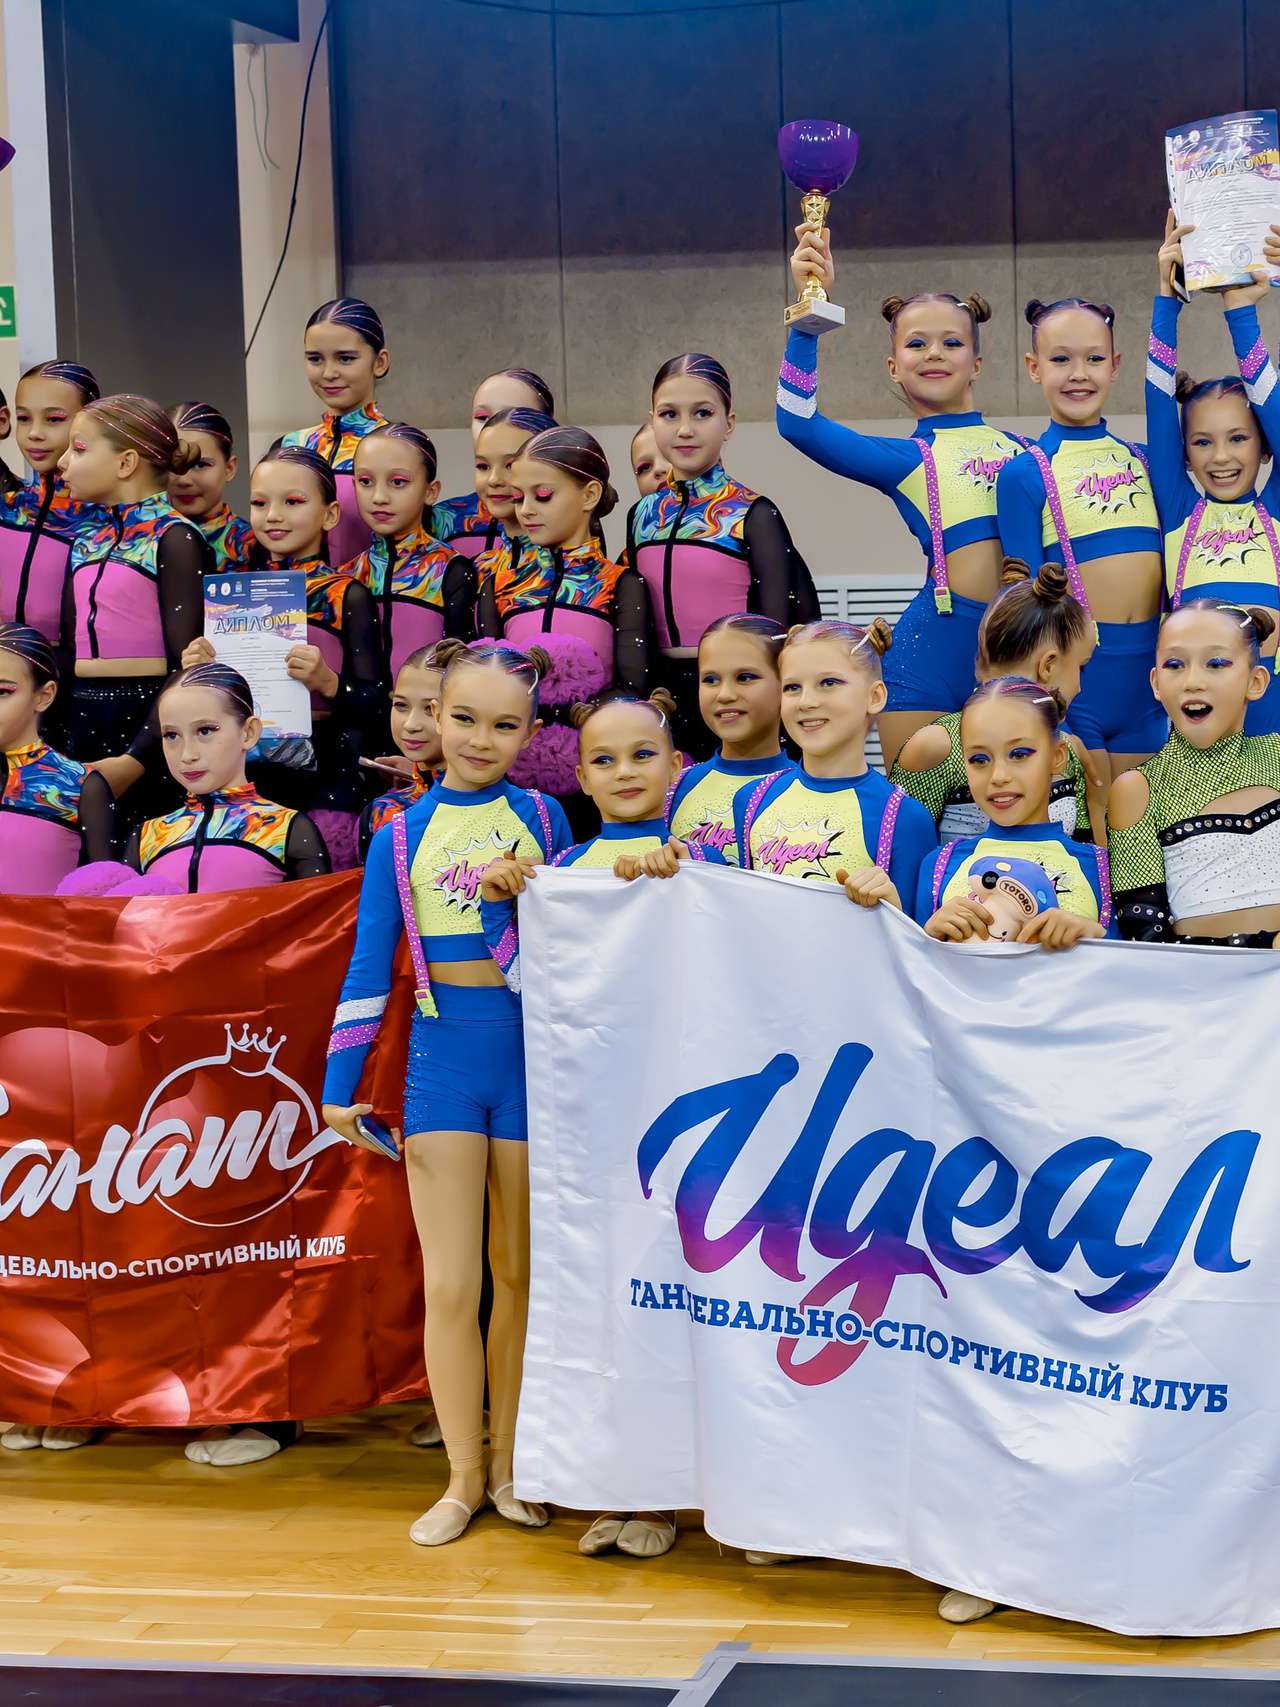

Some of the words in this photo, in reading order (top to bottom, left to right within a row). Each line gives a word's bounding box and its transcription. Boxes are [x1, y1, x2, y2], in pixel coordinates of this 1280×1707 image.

[1075, 470, 1138, 502] Идеал
[213, 615, 290, 635] ДИПЛОМ
[757, 836, 831, 874] Идеал
[1003, 882, 1033, 912] TOTORO
[636, 1042, 1262, 1385] Идеал
[306, 1235, 346, 1258] КЛУБ
[1129, 1374, 1229, 1414] КЛУБ
